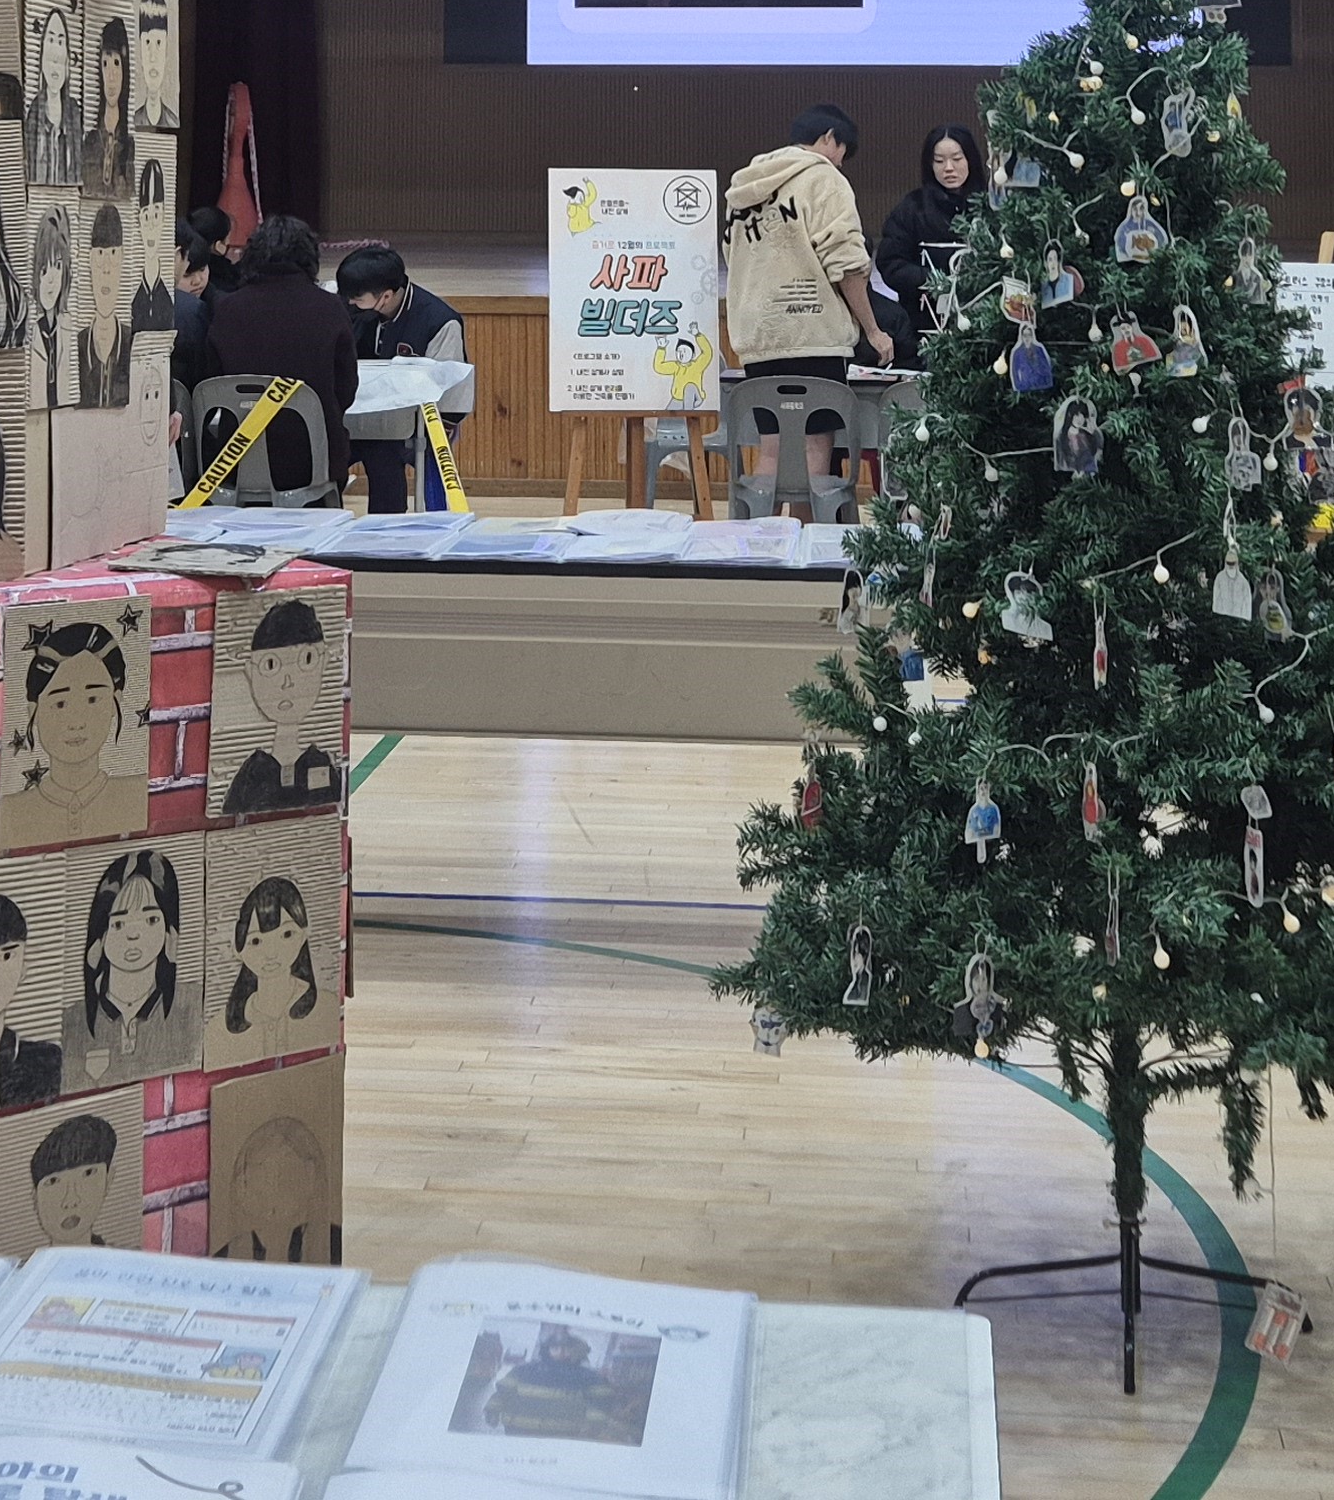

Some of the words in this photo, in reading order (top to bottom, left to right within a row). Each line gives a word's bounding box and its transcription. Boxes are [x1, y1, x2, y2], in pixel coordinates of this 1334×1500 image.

[589, 253, 669, 293] 사파
[577, 298, 683, 337] 빌더즈
[197, 432, 252, 494] CAUTION
